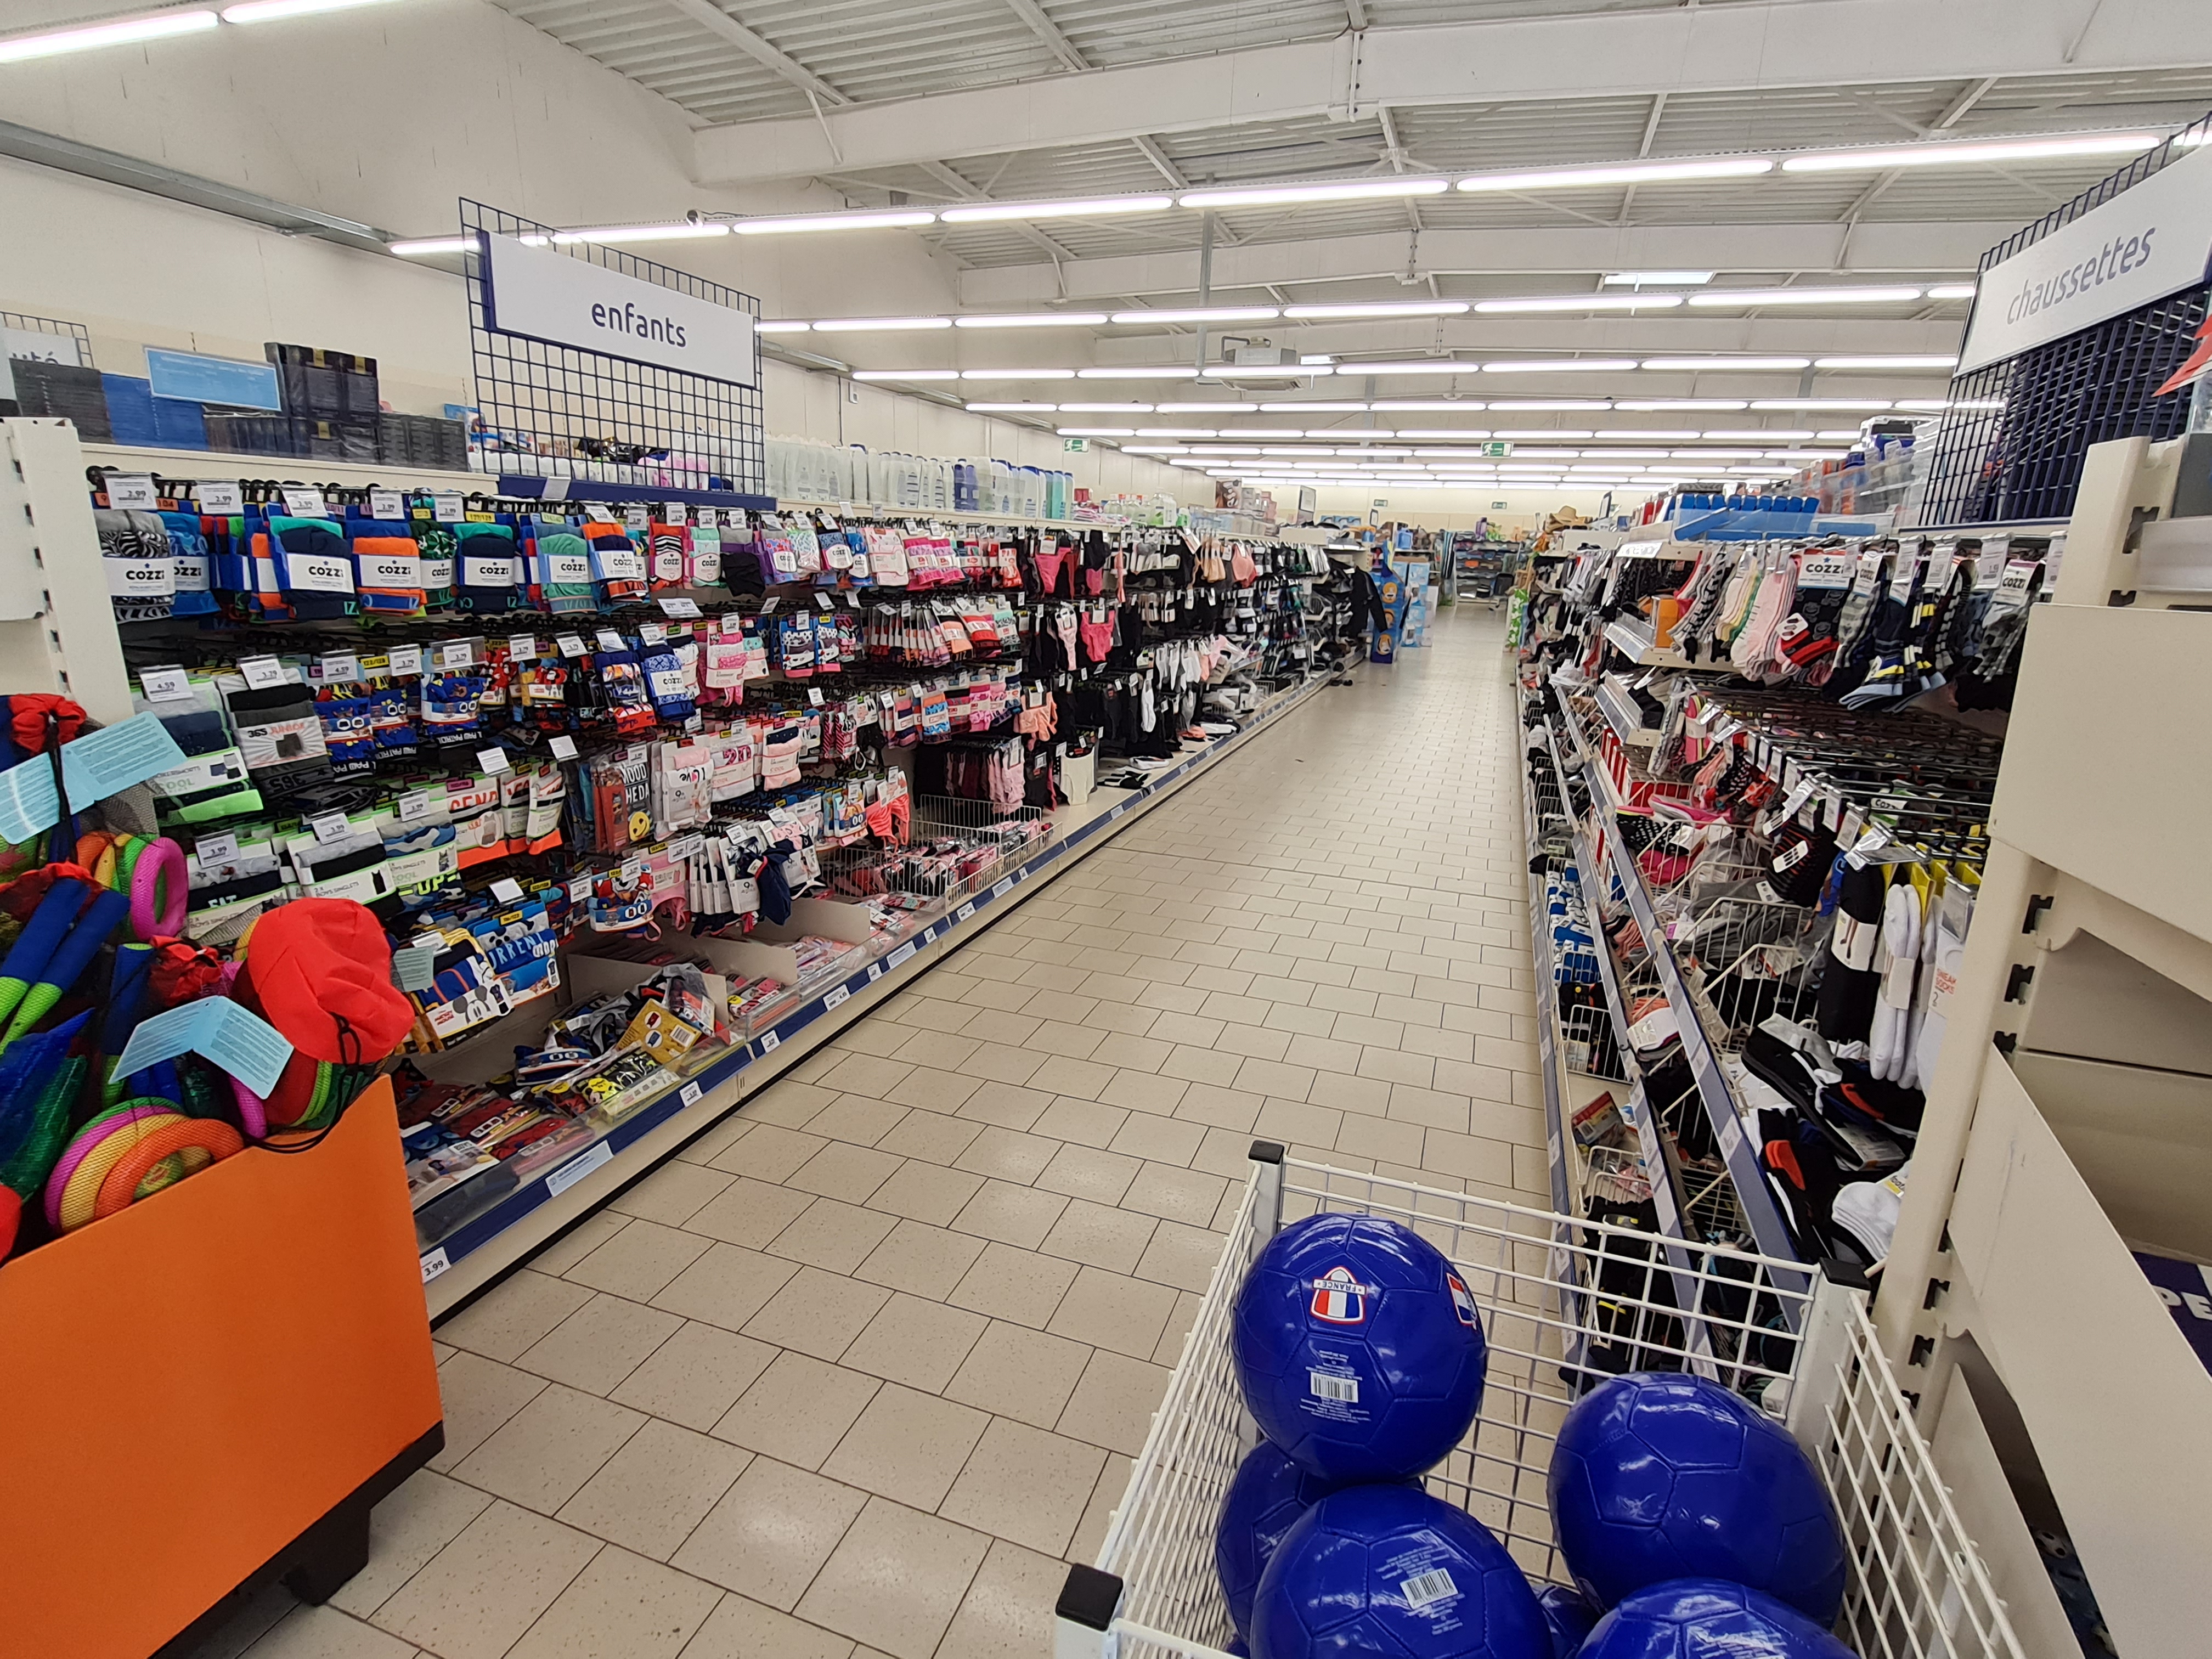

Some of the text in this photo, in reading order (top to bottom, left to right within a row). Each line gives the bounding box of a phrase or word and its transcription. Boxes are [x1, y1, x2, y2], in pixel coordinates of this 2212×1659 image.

[2007, 227, 2156, 325] chaussettes
[591, 302, 687, 347] enfants
[173, 566, 202, 577] OZZi
[247, 727, 268, 738] 365
[424, 1260, 444, 1277] 3.99
[1322, 1280, 1357, 1292] FRANCE
